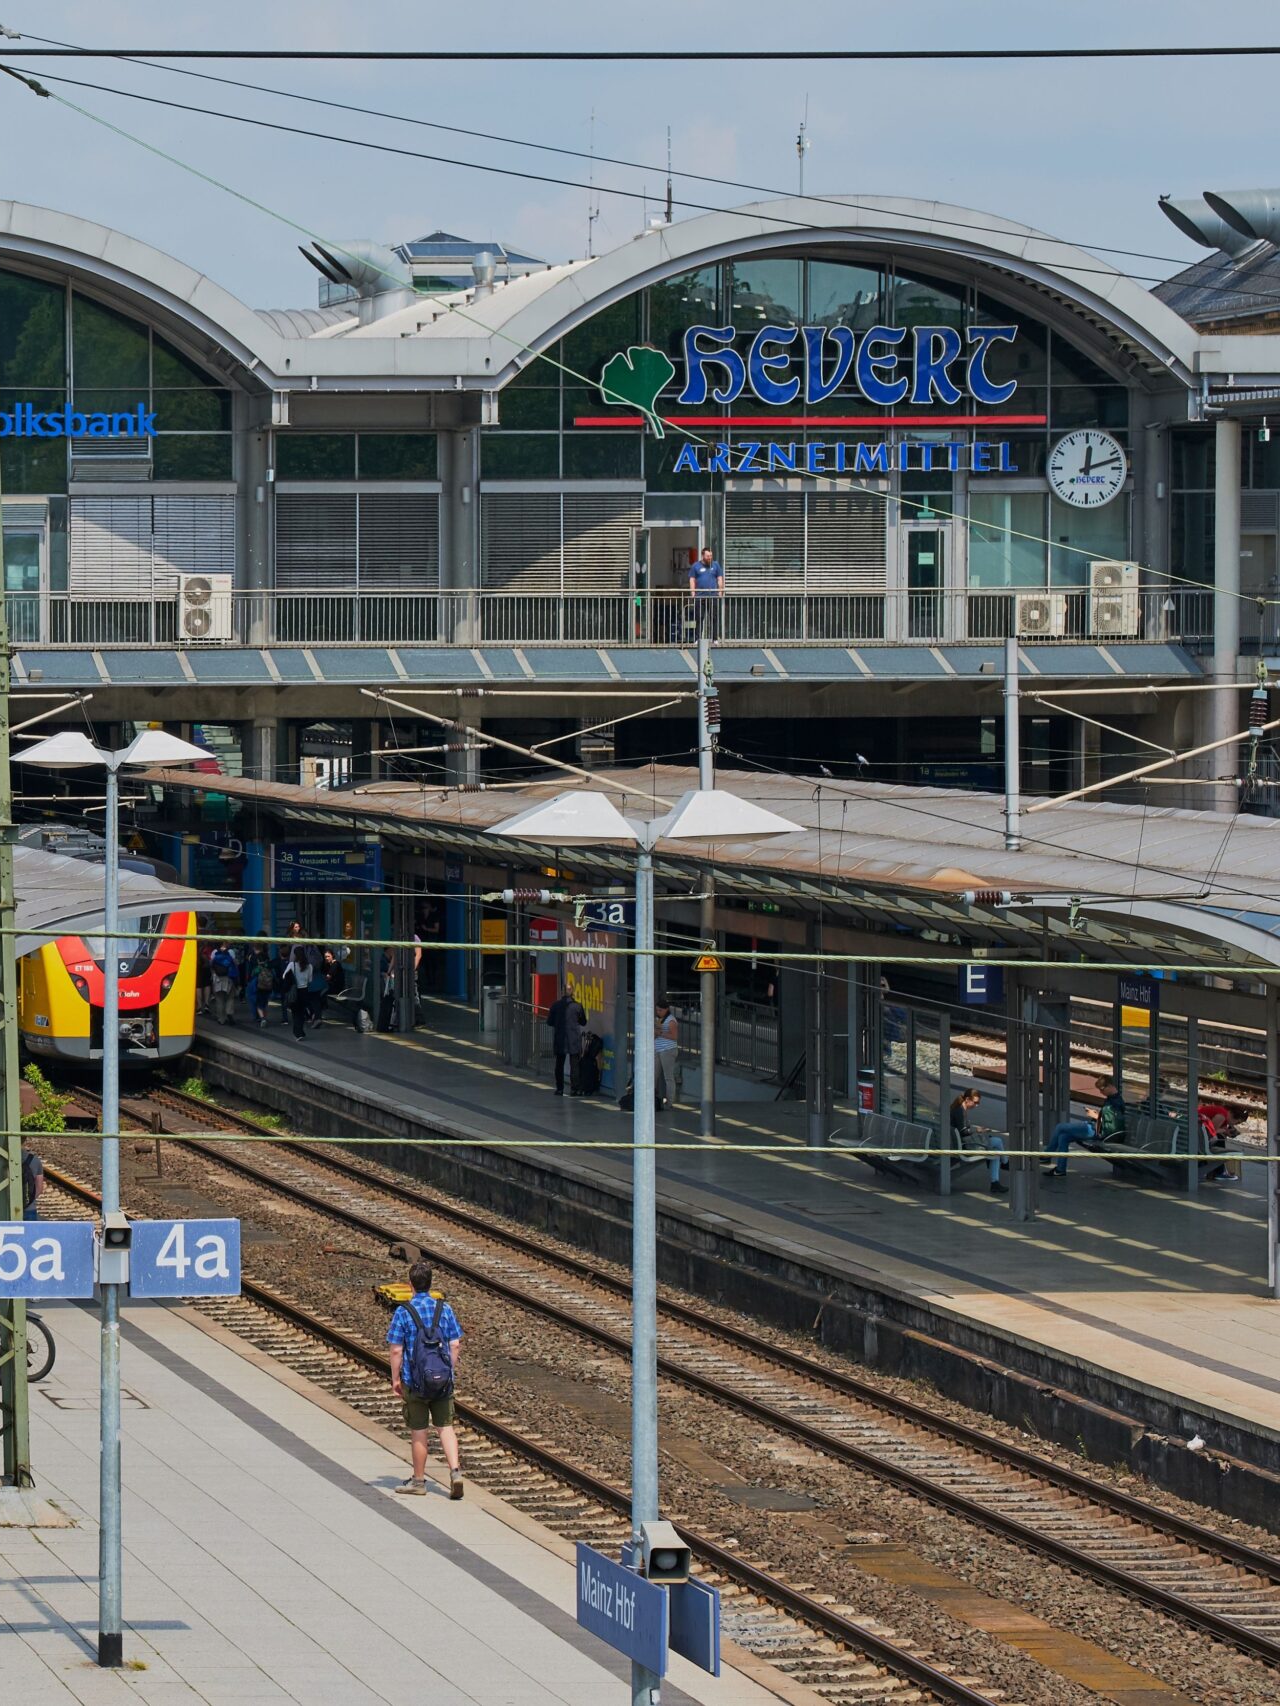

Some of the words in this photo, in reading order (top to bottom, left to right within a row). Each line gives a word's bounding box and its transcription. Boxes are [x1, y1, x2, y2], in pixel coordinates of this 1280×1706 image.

[677, 325, 1018, 405] HEVERT
[673, 441, 1018, 474] ARZNEIMITTEL
[281, 851, 293, 863] 3a
[595, 902, 625, 924] 3a
[966, 963, 986, 993] E
[1120, 982, 1139, 1002] Mainz
[1139, 985, 1151, 1004] Hbf
[155, 1223, 230, 1279] 4a
[581, 1562, 613, 1618] Mainz
[615, 1582, 636, 1632] Hbf
